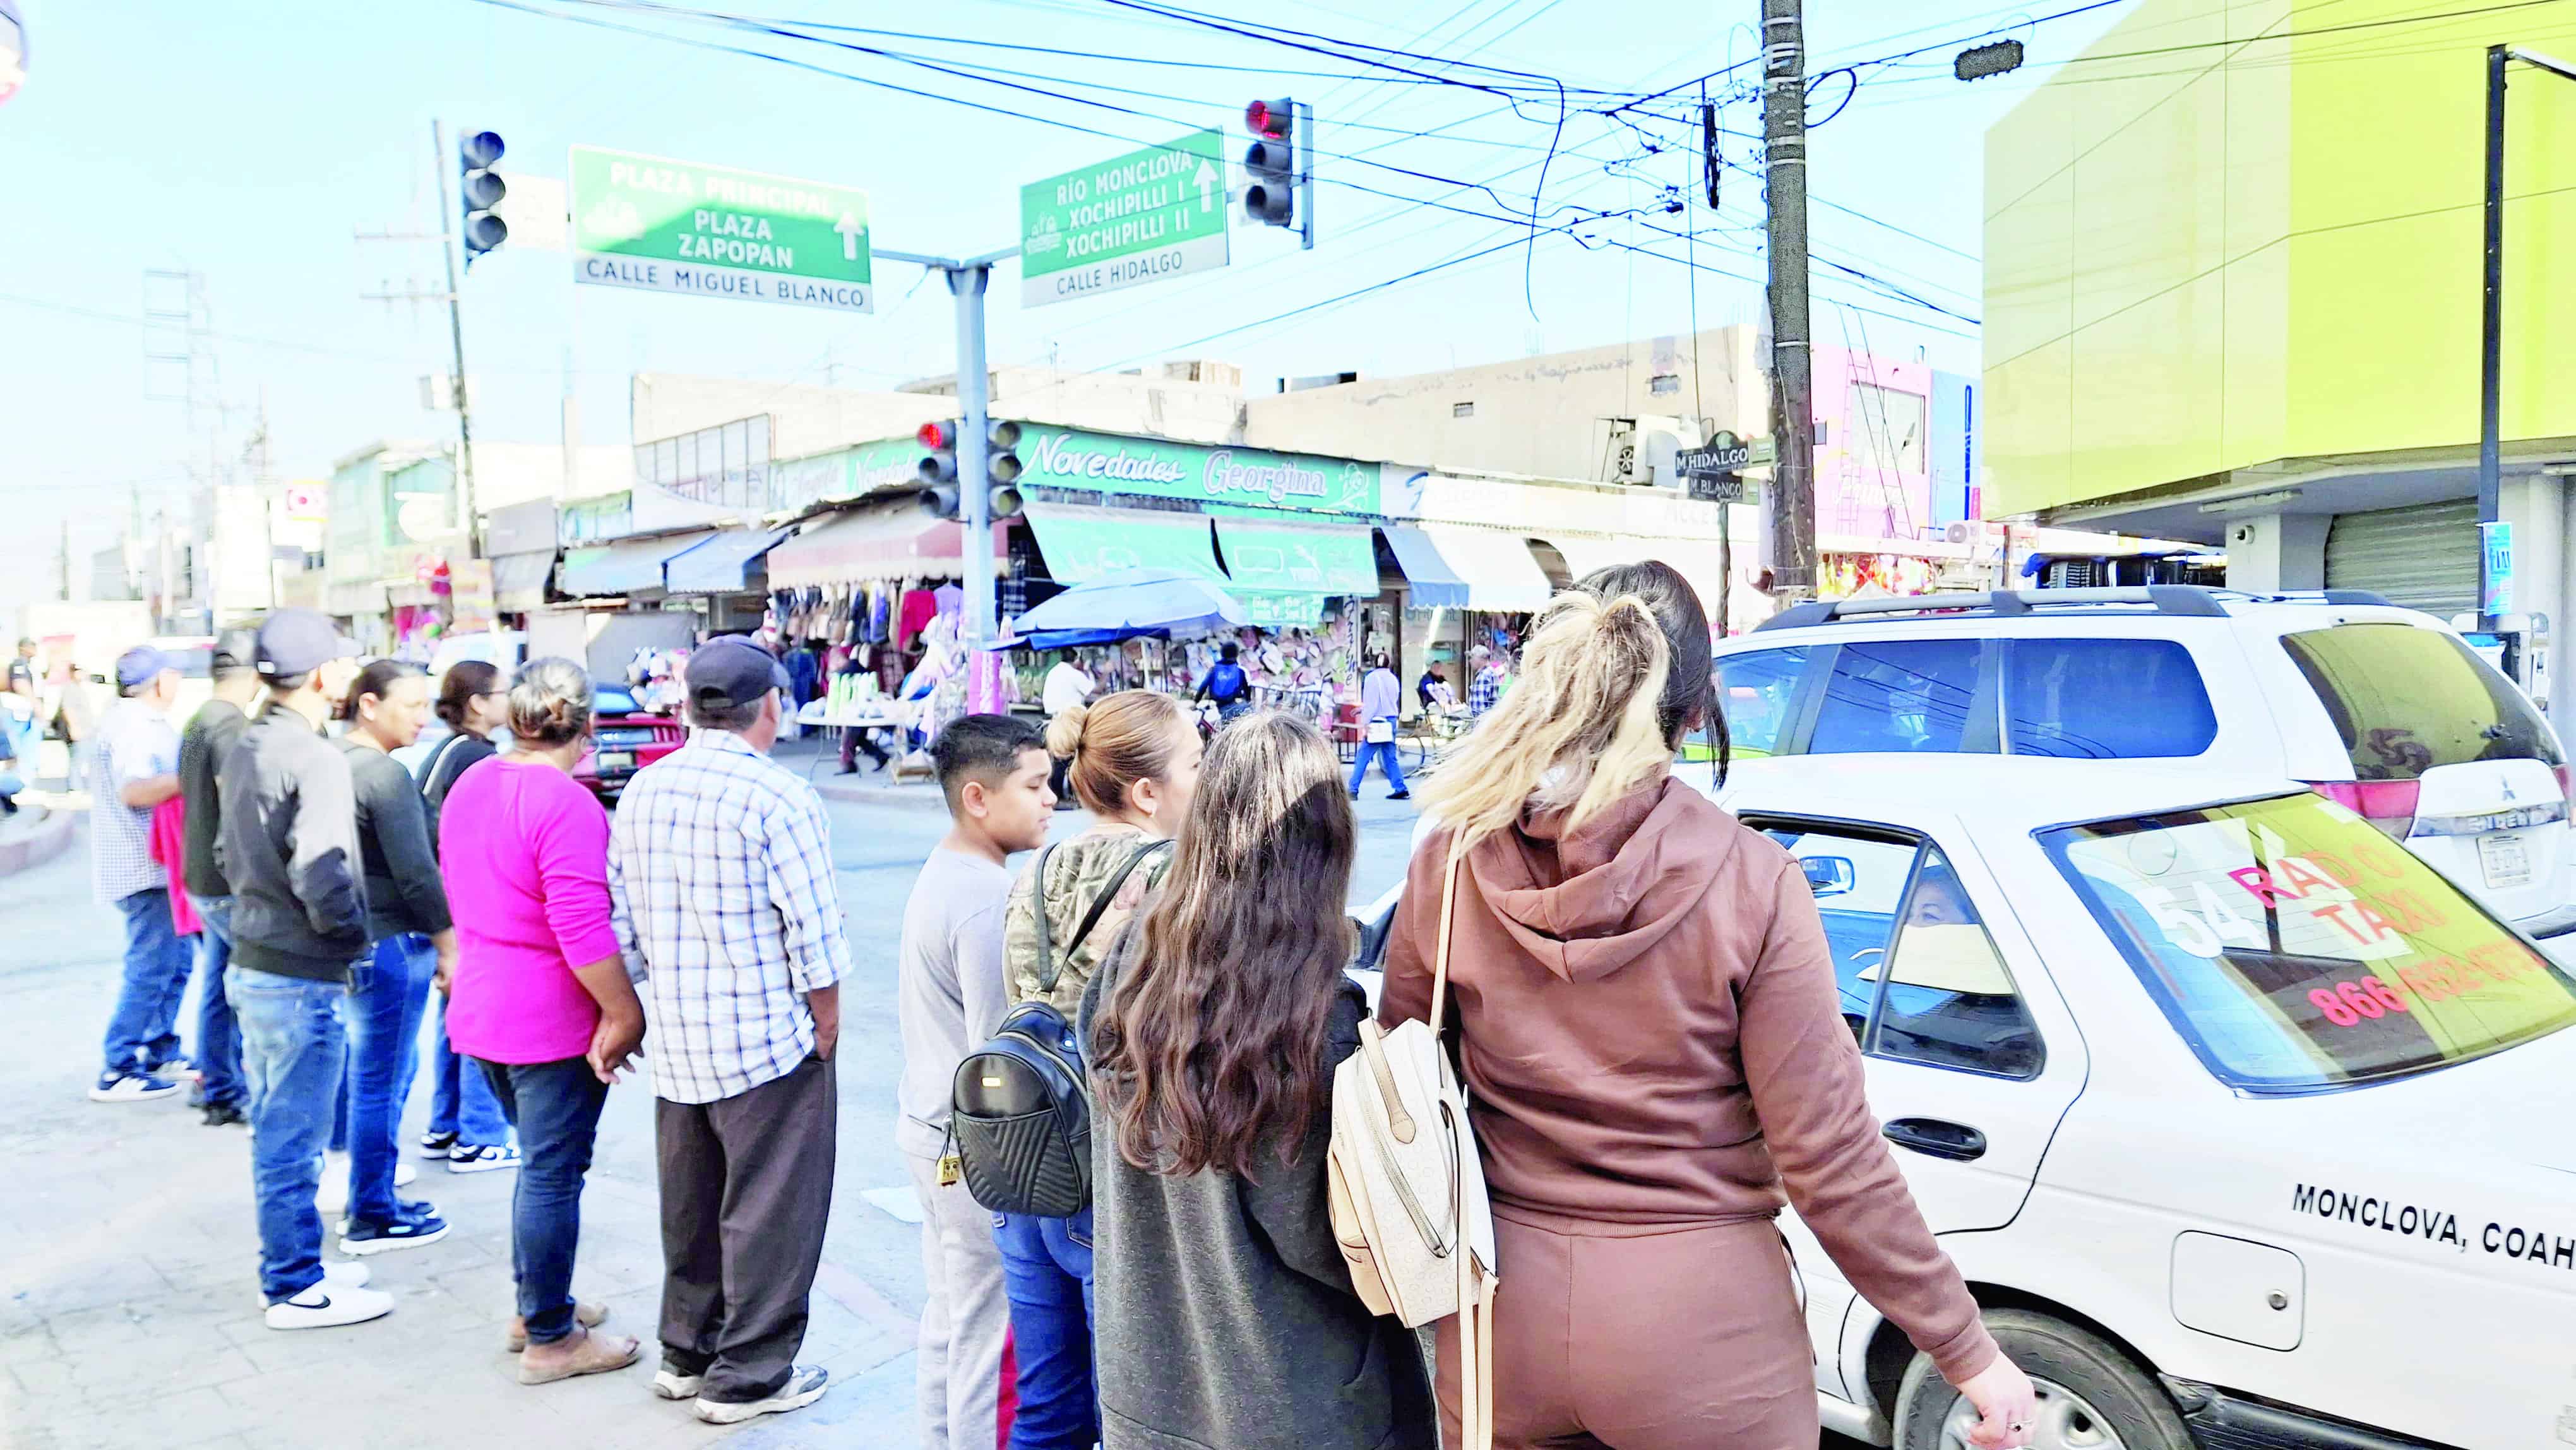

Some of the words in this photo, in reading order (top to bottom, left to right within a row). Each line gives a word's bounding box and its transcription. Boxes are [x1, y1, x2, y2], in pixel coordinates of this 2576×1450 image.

[610, 162, 693, 196] PLAZA
[705, 177, 832, 215] PRINCIPAL
[1095, 151, 1193, 195] MONCLOVA
[694, 209, 773, 241] PLAZA
[1069, 184, 1167, 232] XOCHIPILLI
[1178, 179, 1184, 201] I
[677, 233, 793, 269] ZAPOPAN
[1066, 214, 1165, 260] XOCHIPILLI
[1176, 208, 1190, 232] II
[587, 259, 658, 284] CALLE
[675, 270, 764, 296] MIGUEL
[778, 282, 864, 307] BLANCO
[1057, 270, 1101, 296] CALLE
[1111, 251, 1183, 284] HIDALGO
[1018, 433, 1187, 483] Novedades
[1203, 450, 1327, 503] Georgina
[1689, 448, 1748, 469] HIDALGO
[1701, 478, 1741, 496] BLANCO
[2137, 881, 2270, 959] 54
[2310, 889, 2445, 945] TAXI
[2292, 1183, 2469, 1254] MONCLOVA,
